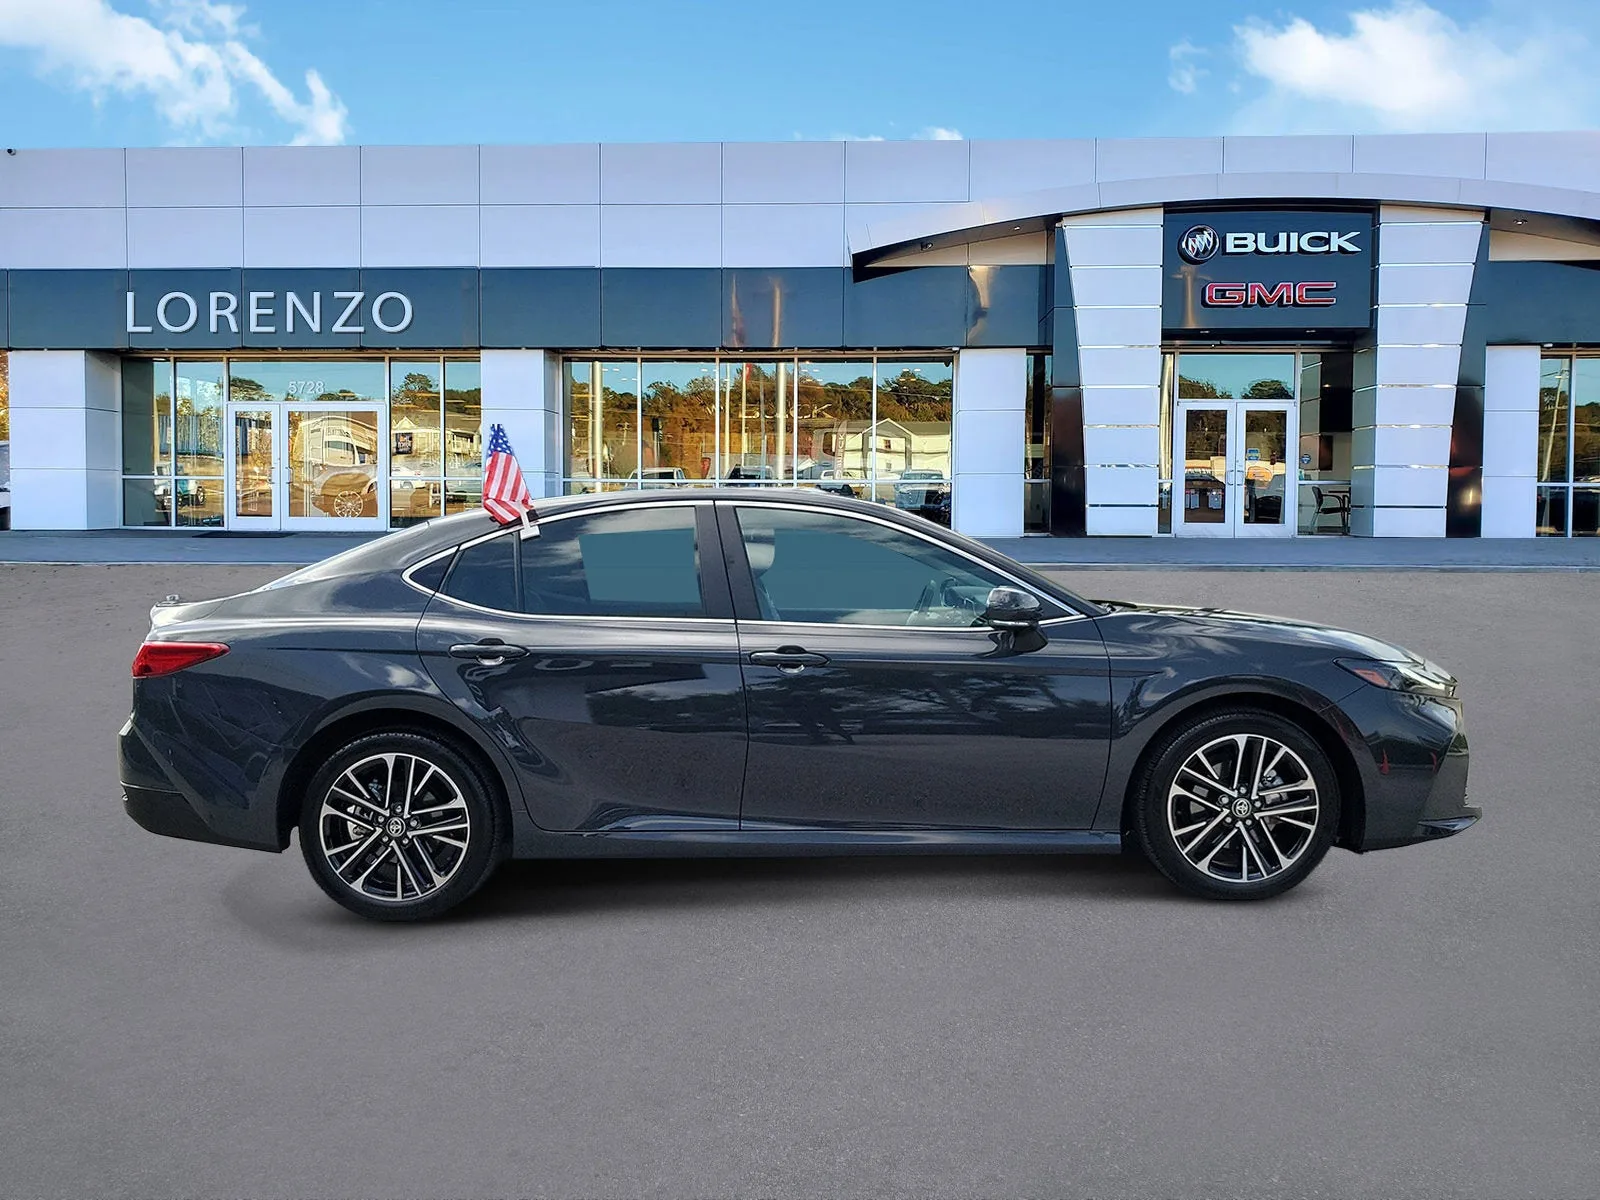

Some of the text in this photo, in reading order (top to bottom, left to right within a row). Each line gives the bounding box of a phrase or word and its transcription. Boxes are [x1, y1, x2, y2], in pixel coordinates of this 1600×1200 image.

[1225, 231, 1362, 253] BUICK
[1205, 281, 1337, 305] GMC
[126, 291, 414, 334] LORENZO
[288, 380, 325, 394] 5728
